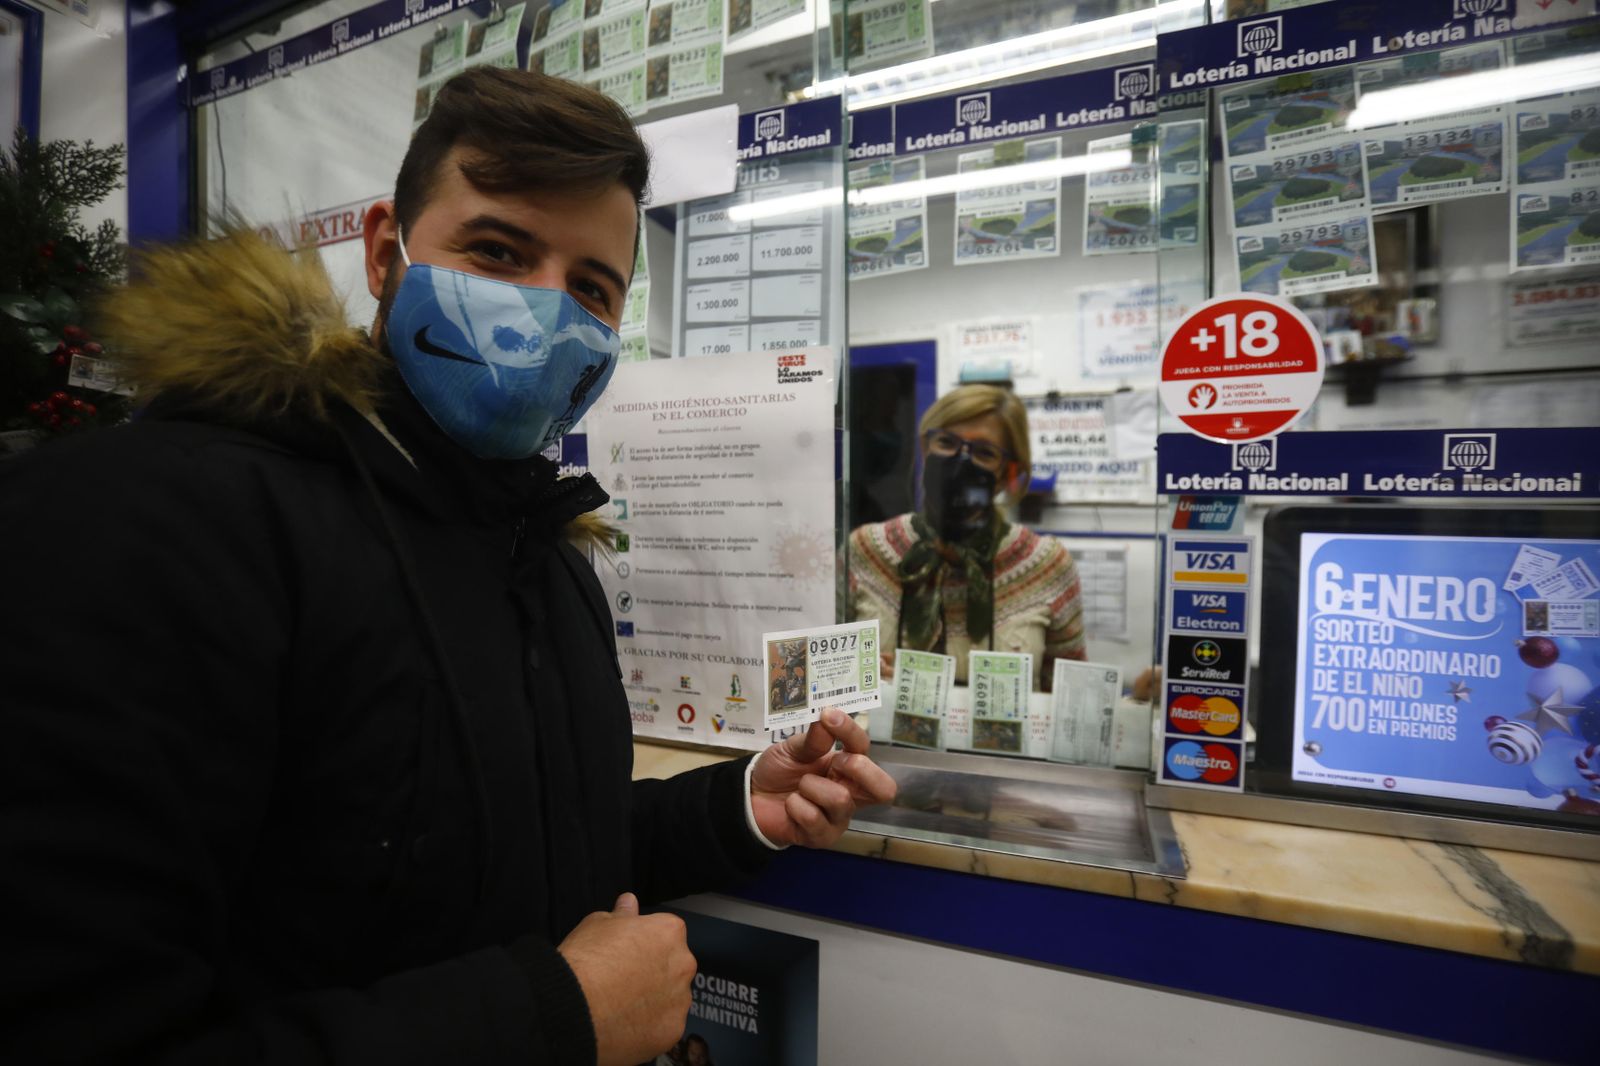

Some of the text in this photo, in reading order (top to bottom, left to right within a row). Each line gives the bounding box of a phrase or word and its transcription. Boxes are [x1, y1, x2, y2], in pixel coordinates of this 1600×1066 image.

[412, 2, 453, 25] Nacional
[1373, 22, 1466, 54] Lotería
[1170, 40, 1357, 89] Lotería Nacional
[1056, 103, 1125, 127] Lotería
[766, 129, 831, 154] Nacional
[906, 114, 1046, 151] Lotería Nacional
[1404, 128, 1473, 148] 13134
[1273, 150, 1335, 172] 29793
[1280, 224, 1342, 244] 29793
[697, 252, 740, 267] 2.200.000
[761, 245, 813, 259] 11.700.000
[696, 298, 739, 311] 1.300.000
[1190, 310, 1280, 359] +18
[702, 344, 731, 355] 17.000
[777, 370, 823, 378] PARAMOS
[1174, 360, 1304, 375] JUEGA CON RESPONSABILIDAD
[1222, 383, 1264, 391] PROHIBIDA
[1235, 391, 1259, 399] VENTA
[613, 392, 796, 413] MEDIDAS HIGIÉNICO-SANITARIAS
[1222, 397, 1292, 406] AUTOPROHIBIDOS
[652, 408, 747, 422] EN EL COMERCIO
[1166, 473, 1348, 491] Lotería Nacional
[1364, 472, 1582, 492] Lotería Nacional
[1179, 501, 1235, 515] UnionPay
[1185, 553, 1236, 570] VISA
[1191, 594, 1227, 608] VISA
[1315, 562, 1343, 612] 6
[1353, 573, 1497, 623] ENERO
[1177, 616, 1240, 631] Electron
[1314, 618, 1395, 645] SORTEO
[624, 647, 667, 658] GRACIAS
[668, 651, 689, 661] POR
[691, 653, 705, 662] SU
[810, 634, 857, 655] 09077
[1313, 643, 1501, 679] EXTRAORDINARIO
[864, 675, 873, 683] 20
[1181, 667, 1230, 680] ServiRed
[898, 667, 913, 711] 59817
[1312, 669, 1423, 699] DE EL NIÑO
[975, 673, 989, 717] 28097
[1311, 694, 1458, 733] 700 MILLONES
[1368, 719, 1457, 742] EN PREMIOS
[695, 973, 759, 1005] OCURRE
